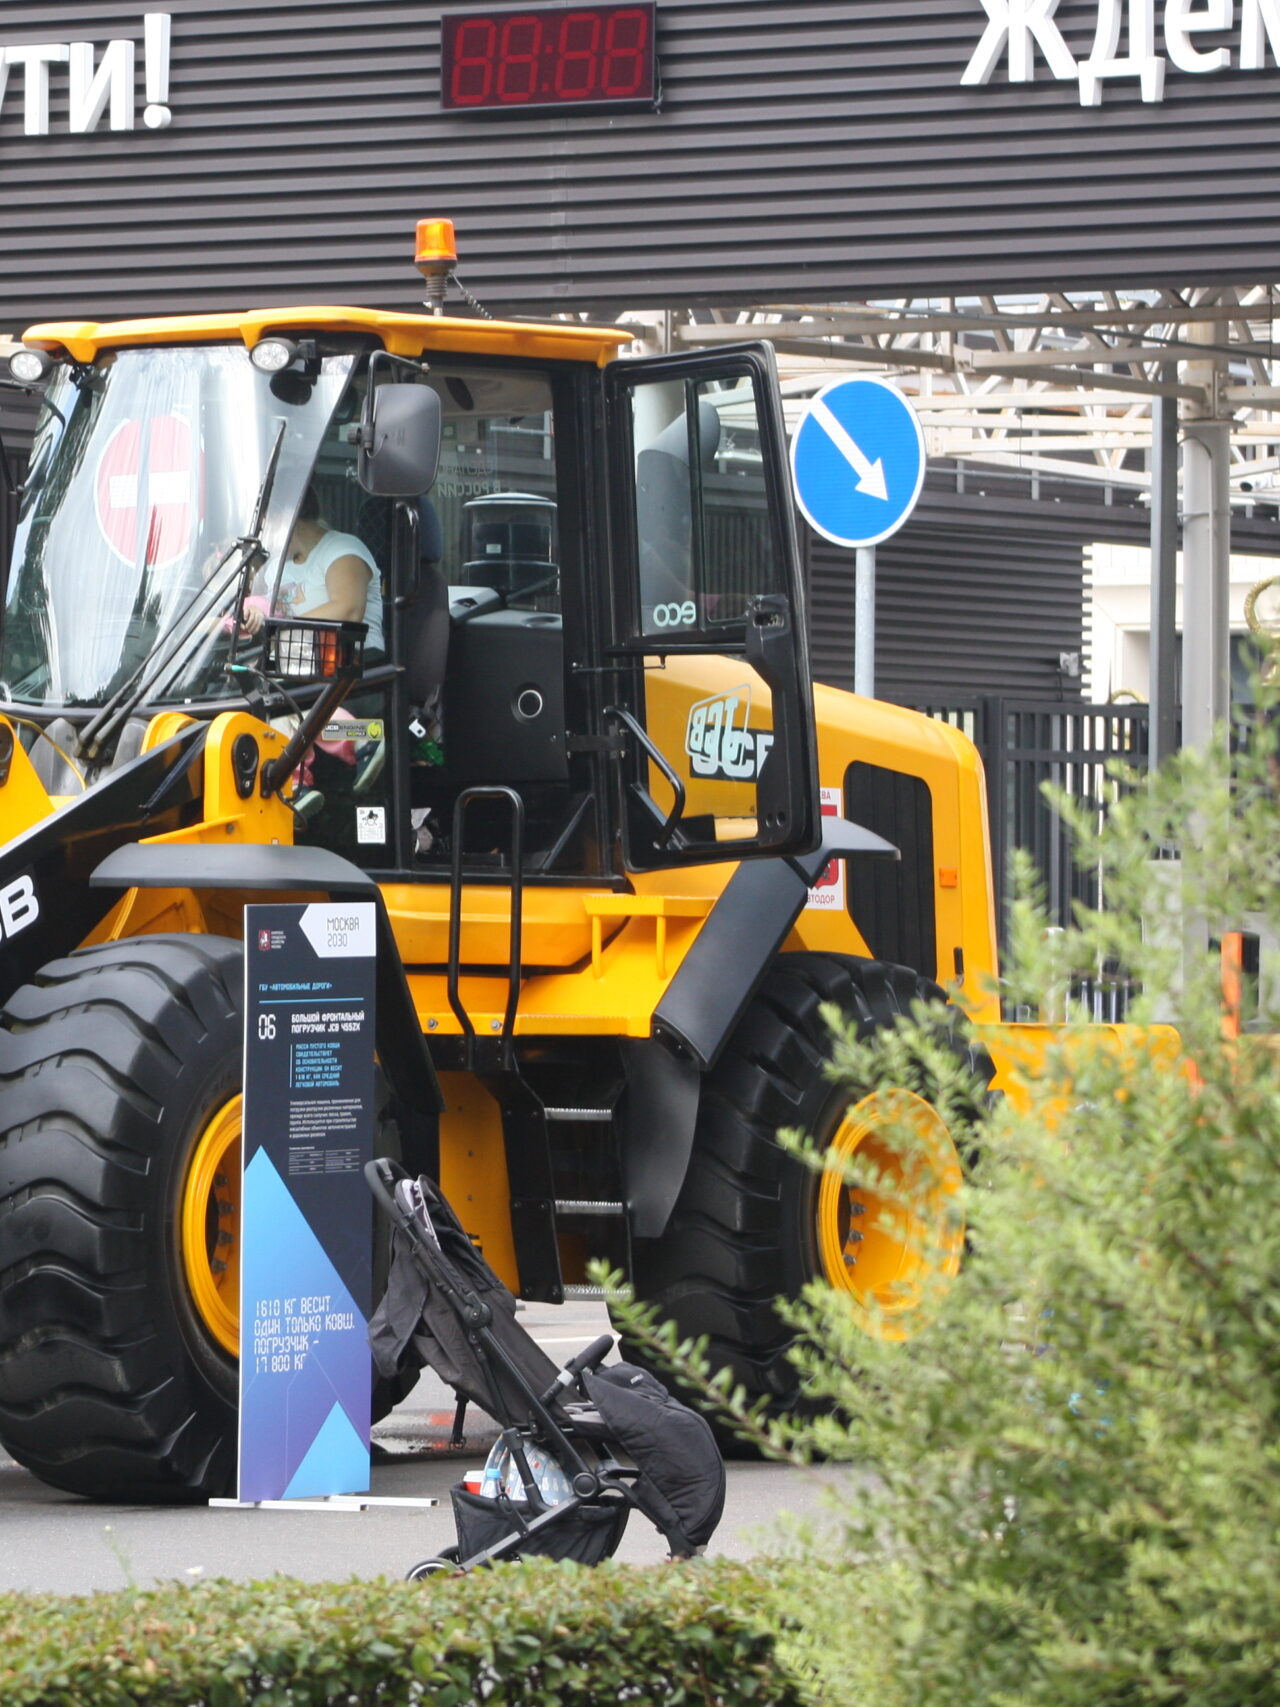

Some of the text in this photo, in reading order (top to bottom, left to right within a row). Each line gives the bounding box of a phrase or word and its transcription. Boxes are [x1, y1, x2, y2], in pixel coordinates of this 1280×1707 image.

[807, 894, 835, 904] ВТОДОР
[326, 917, 360, 932] МОСКВА
[327, 933, 348, 947] 2030
[291, 1010, 365, 1023] БОЛЬШОЙ ФРОНТАЛЬНЫЙ
[258, 1014, 276, 1040] 06
[291, 1023, 325, 1034] ПОГРУЗЧИК
[327, 1023, 339, 1032] JCB
[256, 1296, 330, 1317] 1610 КГ ВЕСИТ
[254, 1313, 355, 1337] ОДИН ТОЛЬКО КОВШ.
[254, 1335, 308, 1354] ПОГРУЗЧИК
[256, 1353, 306, 1374] 17 800 КГ
